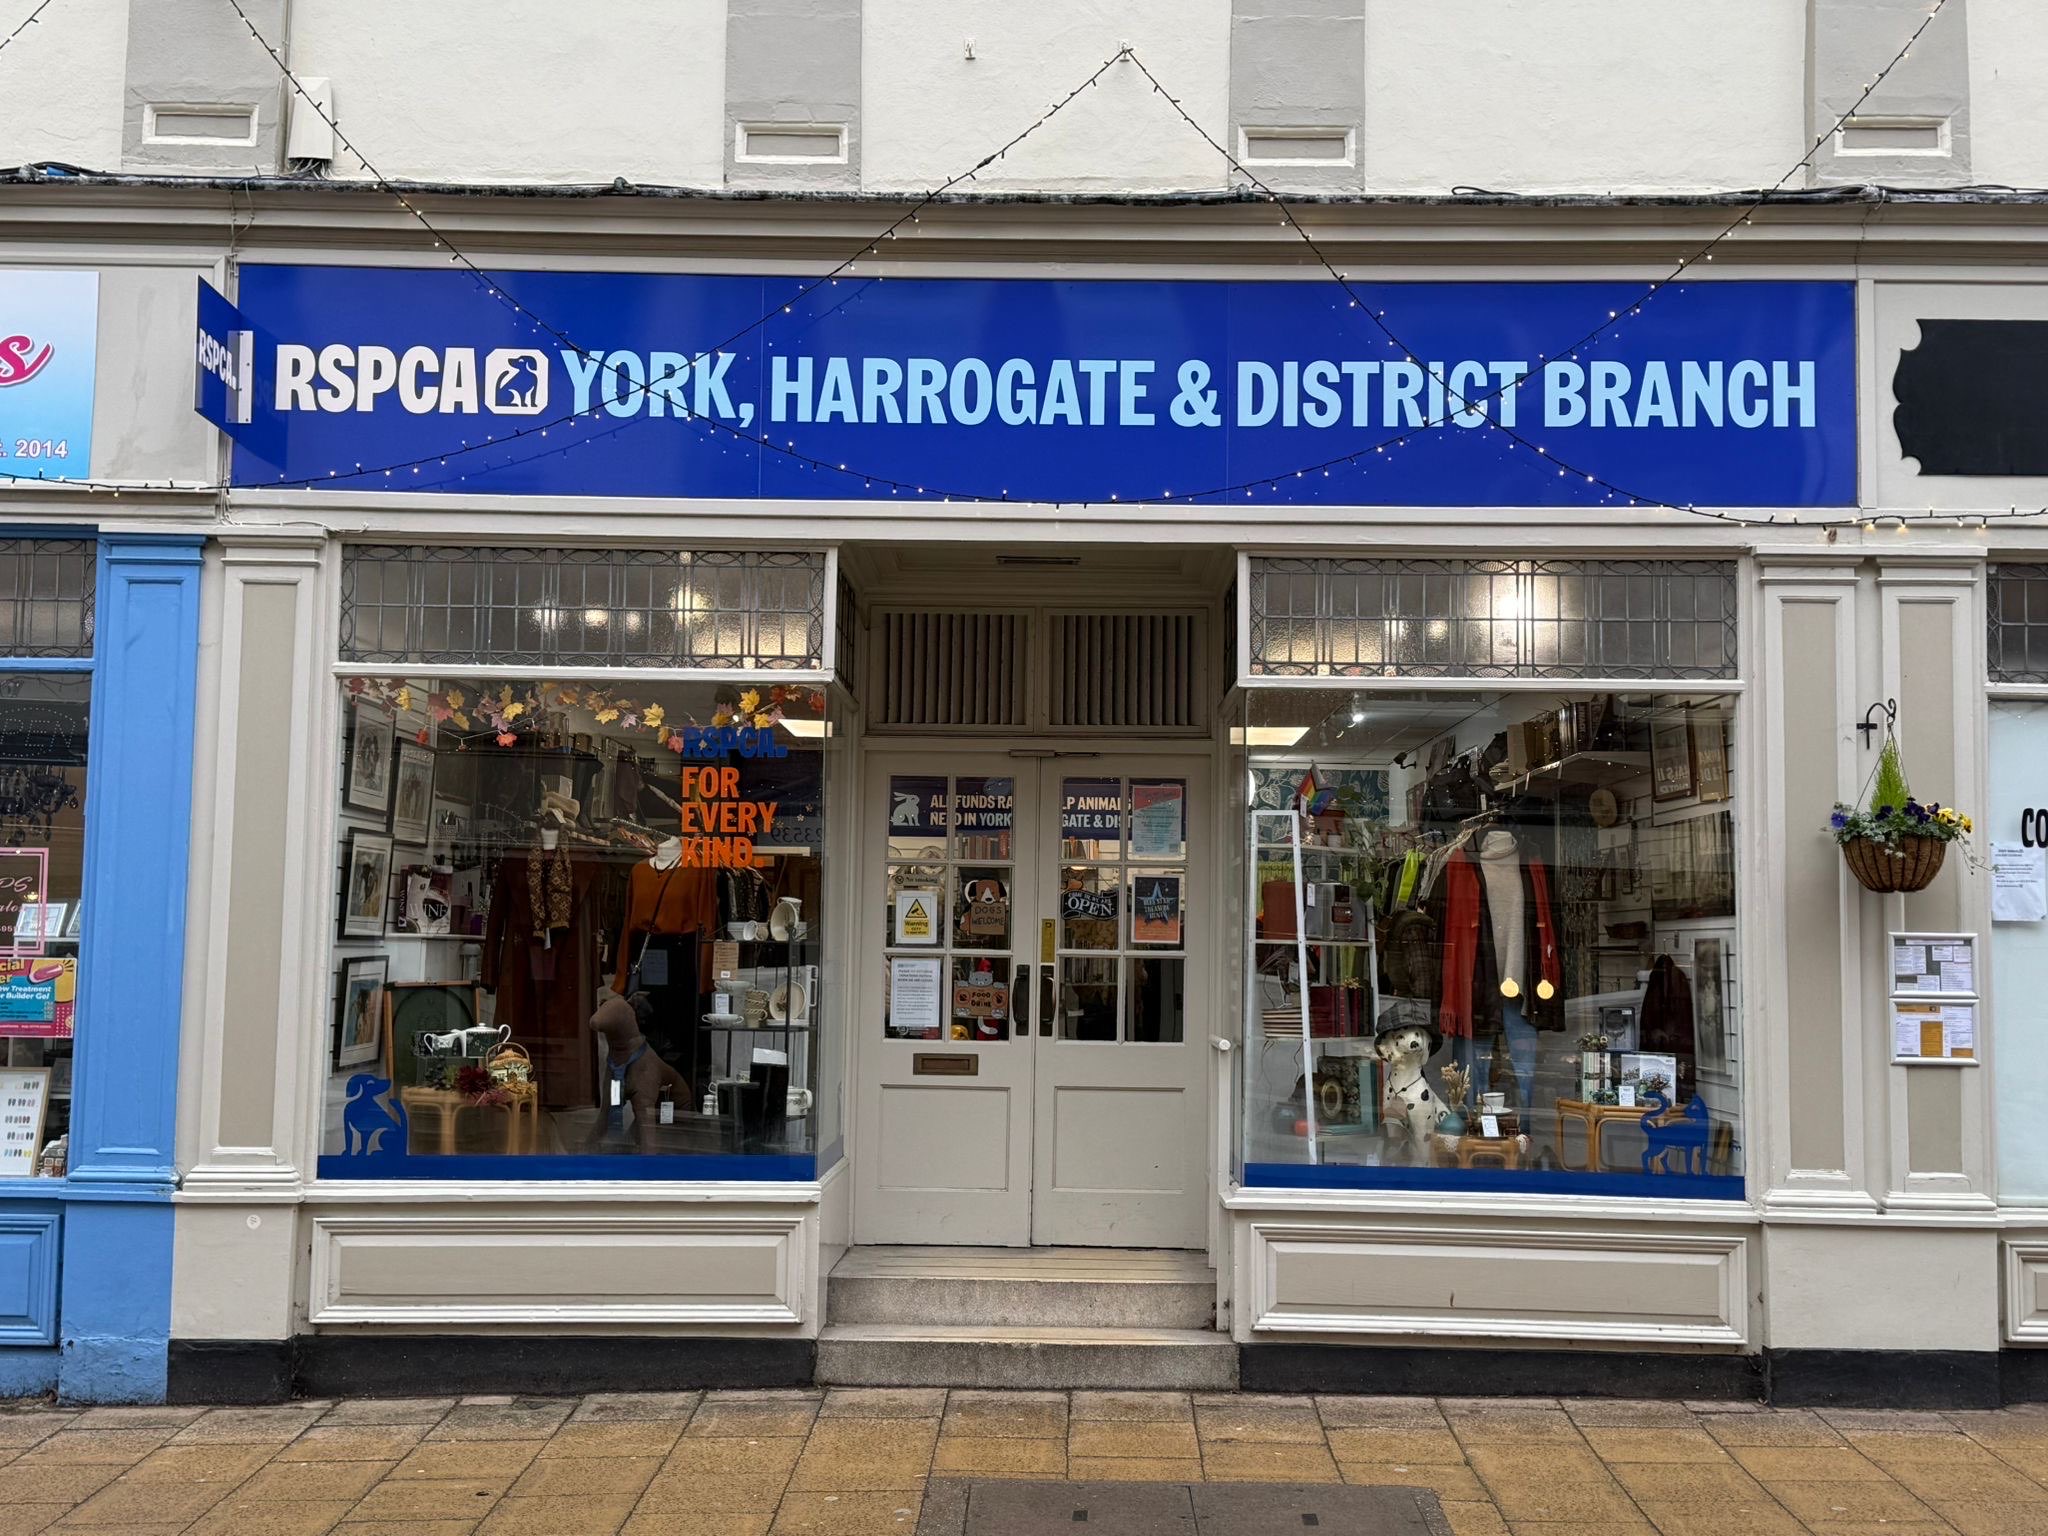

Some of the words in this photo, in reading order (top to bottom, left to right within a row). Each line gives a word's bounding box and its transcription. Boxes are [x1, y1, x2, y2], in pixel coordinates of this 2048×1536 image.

[275, 344, 479, 415] RSPCA
[560, 349, 755, 428] YORK,
[771, 356, 1155, 426] HARROGATE
[1169, 358, 1221, 428] &
[1237, 360, 1529, 429] DISTRICT
[1544, 360, 1816, 429] BRANCH
[15, 439, 68, 458] 2014
[682, 766, 740, 798] FOR
[681, 802, 778, 833] EVERY
[963, 812, 977, 826] IN
[974, 905, 1002, 915] DOGS
[1067, 895, 1113, 916] OPEN
[11, 985, 52, 993] Treatment
[36, 992, 50, 1000] Gel
